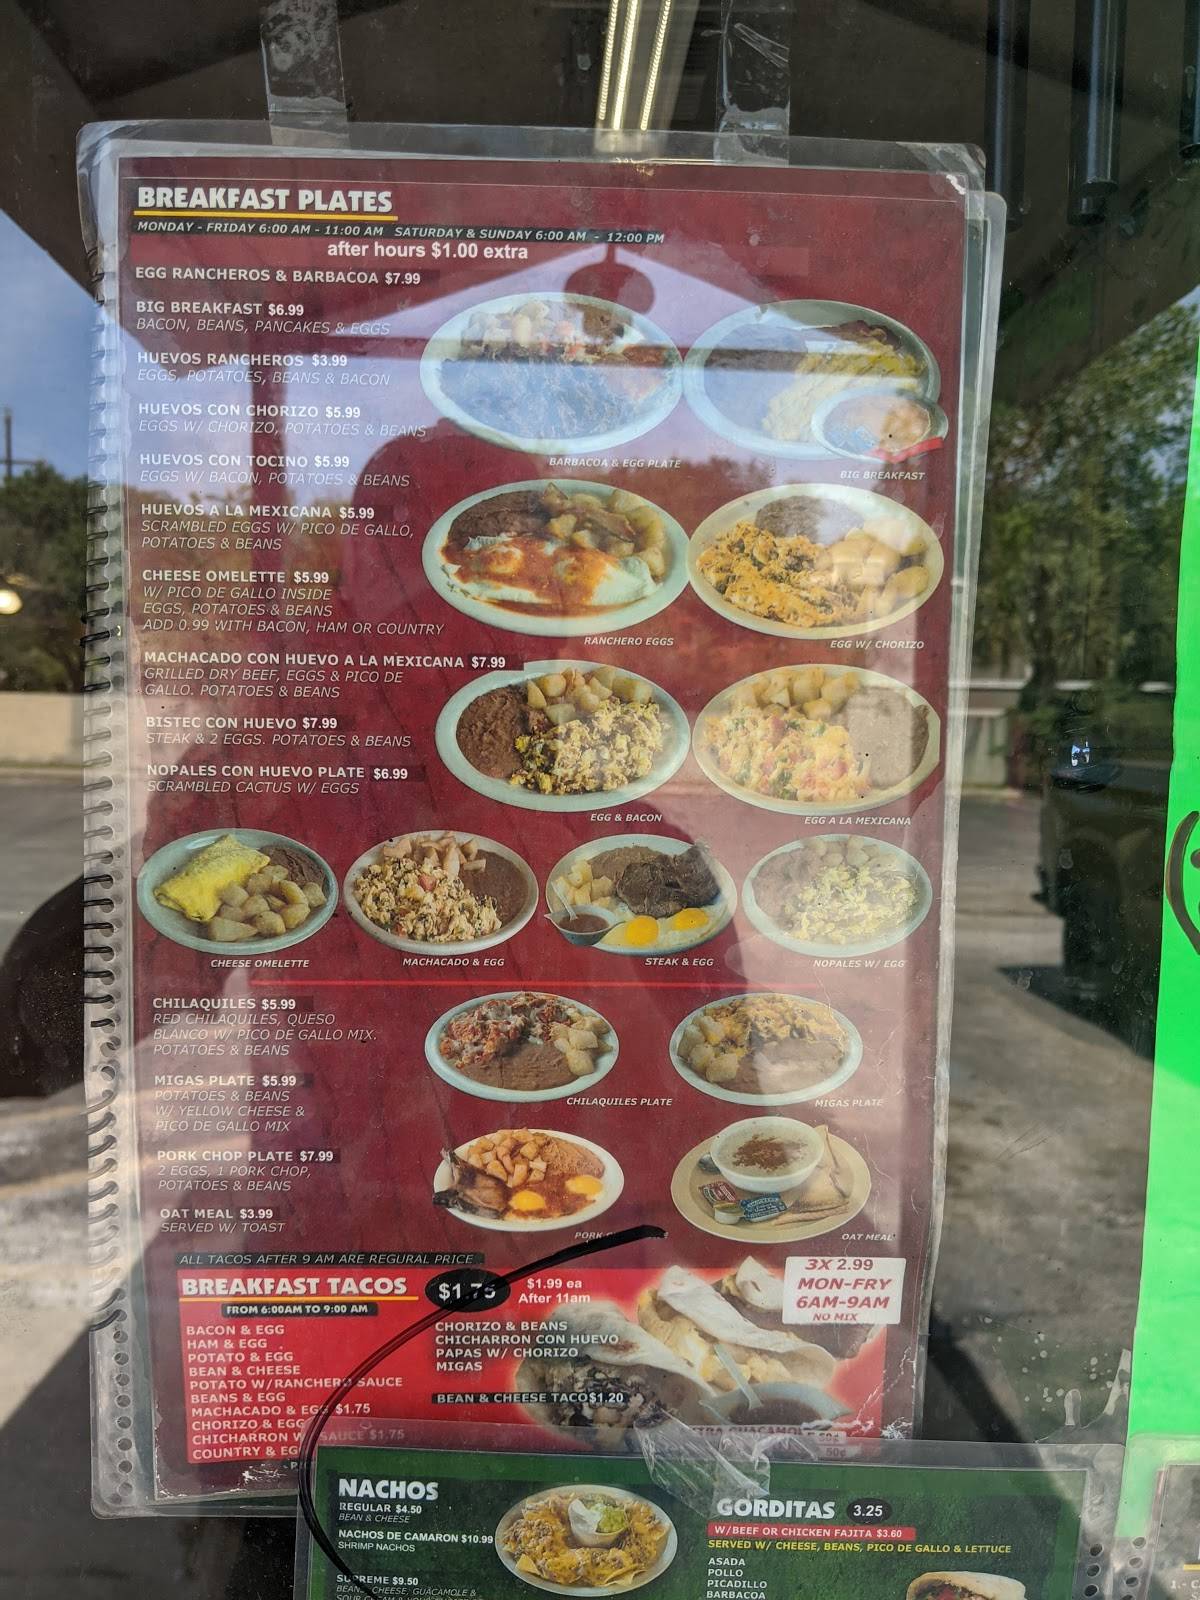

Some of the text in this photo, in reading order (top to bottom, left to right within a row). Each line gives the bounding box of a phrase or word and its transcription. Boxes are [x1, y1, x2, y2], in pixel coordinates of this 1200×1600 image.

[138, 187, 393, 212] BREAKFAST PLATES
[138, 222, 194, 232] MONDAY
[207, 223, 256, 233] FRIDAY
[259, 224, 288, 233] 6:00
[291, 224, 311, 233] AM
[324, 225, 360, 235] 11:00
[363, 226, 383, 236] AM
[395, 228, 463, 238] SATURDAY
[467, 229, 476, 238] &
[479, 229, 532, 240] SUNDAY
[536, 231, 564, 241] 6:00
[567, 231, 587, 241] AM
[607, 232, 643, 242] 12:00
[646, 233, 664, 243] PM
[327, 242, 528, 259] after hours $1.00 extra
[135, 267, 420, 285] EGG RANCHEROS & BARBACOA $7.99
[136, 301, 304, 317] BIG BREAKFAST $6.99
[138, 352, 347, 368] HUEVOS RANCHEROS $3.99
[840, 470, 925, 481] BIG BREAKFAST
[142, 504, 374, 520] HUEVOS A LA MEXICANA $5.99
[141, 520, 414, 538] SCRAMBLED EGGS W/ PICO DE GALLO,
[142, 537, 282, 550] POTATOES & BEANS
[142, 570, 329, 584] CHEESE OMELETTE $5.99
[584, 637, 674, 646] RANCHERO EGGS
[144, 652, 505, 669] MACHACADO CON HUEVO A LA MEXICANA $7.99
[146, 717, 337, 730] BISTEC CON HUEVO $7.99
[591, 814, 662, 822] EGG & BACON
[211, 959, 309, 968] CHEESE OMELETTE
[402, 958, 504, 966] MACHACADO & EGG
[645, 958, 714, 966] STEAK & EGG
[153, 998, 296, 1011] CHILAQUILES $5.99
[153, 1014, 335, 1026] RED CHILAQUILES, QUESO
[567, 1098, 672, 1107] CHILAQUILES PLATE
[157, 1151, 334, 1162] PORK CHOP PLATE $7.99
[160, 1209, 273, 1220] OAT MEAL $3.99
[161, 1223, 285, 1233] SERVED W/ TOAST
[180, 1254, 473, 1264] ALL TACOS AFTER 9 AM ARE REGURAL PRICE
[805, 1259, 873, 1270] 3X 2.99
[182, 1278, 407, 1295] BREAKFAST TACOS
[527, 1279, 582, 1289] $1.99 ea
[798, 1278, 891, 1290] MON-FRY
[518, 1293, 590, 1303] After 11am
[797, 1297, 890, 1309] 6AM-9AM
[226, 1305, 368, 1314] FROM 6:00AM TO 9:00 AM
[813, 1313, 858, 1321] NO MIX
[187, 1325, 284, 1336] BACON & EGG
[436, 1348, 578, 1359] PAPAS W/ CHORIZO
[189, 1365, 300, 1377] BEAN & CHEESE
[436, 1362, 482, 1372] MIGAS
[339, 1479, 438, 1500] NACHOS
[340, 1503, 422, 1514] REGULAR $4.50
[717, 1499, 883, 1519] GORDITAS 3.25
[339, 1530, 493, 1543] NACHOS DE CAMARON $10.99
[715, 1526, 902, 1537] W/BEEF OR CHICKEN FAJITA $3.60
[338, 1542, 415, 1552] SHRIMP NACHOS
[708, 1558, 745, 1566] ASADA
[708, 1569, 743, 1577] POLLO
[707, 1580, 767, 1588] PICADILLO
[706, 1591, 765, 1599] BARBACOA
